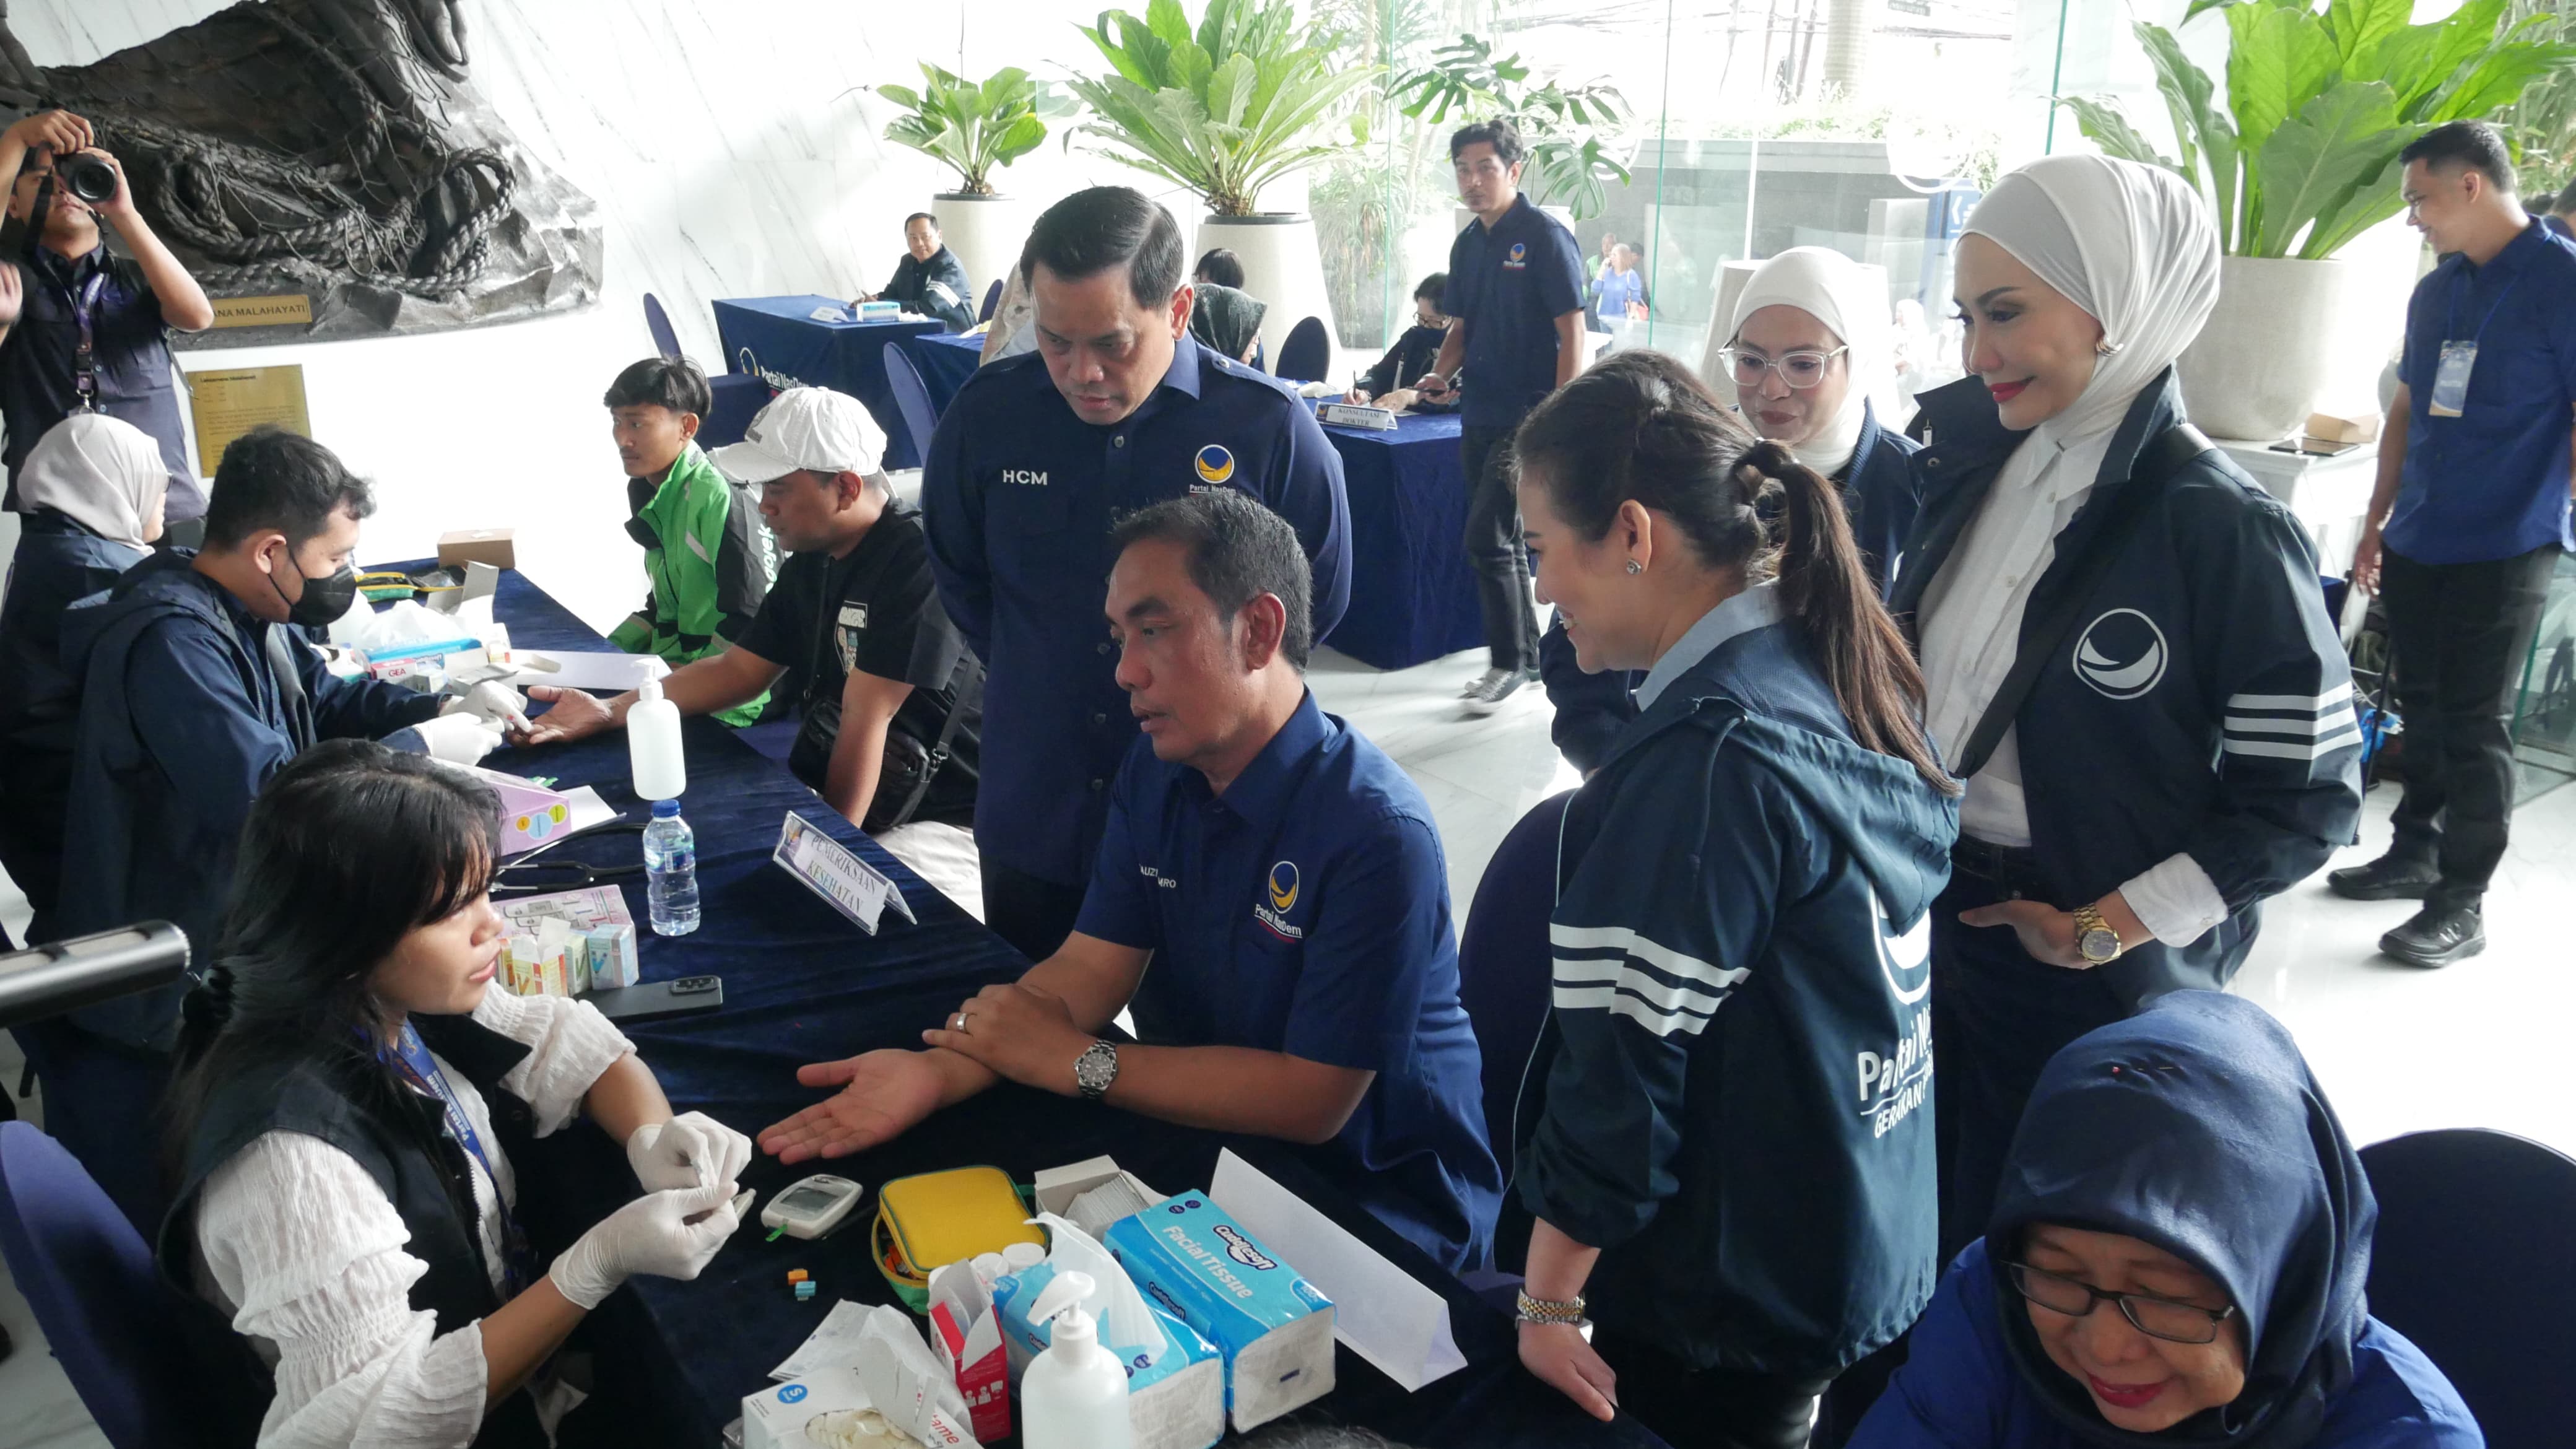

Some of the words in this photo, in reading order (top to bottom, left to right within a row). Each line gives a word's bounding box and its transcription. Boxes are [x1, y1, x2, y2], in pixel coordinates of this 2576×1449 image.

[236, 304, 305, 316] MALAHAYATI
[760, 365, 781, 388] Partai
[1338, 407, 1380, 419] KONSULTASI
[1342, 417, 1369, 426] DOKTER
[1003, 469, 1048, 485] HCM
[1190, 484, 1209, 492] Partai
[1211, 485, 1237, 494] NasDem
[758, 523, 777, 582] gojek
[388, 668, 406, 677] GEA
[811, 835, 876, 894] PEMERIKSAAN
[806, 860, 864, 914] KESEHATAN
[1255, 903, 1274, 923] Partai
[1162, 1225, 1208, 1260] Facial
[1202, 1255, 1253, 1299] Tissue
[931, 1414, 960, 1445] ame
